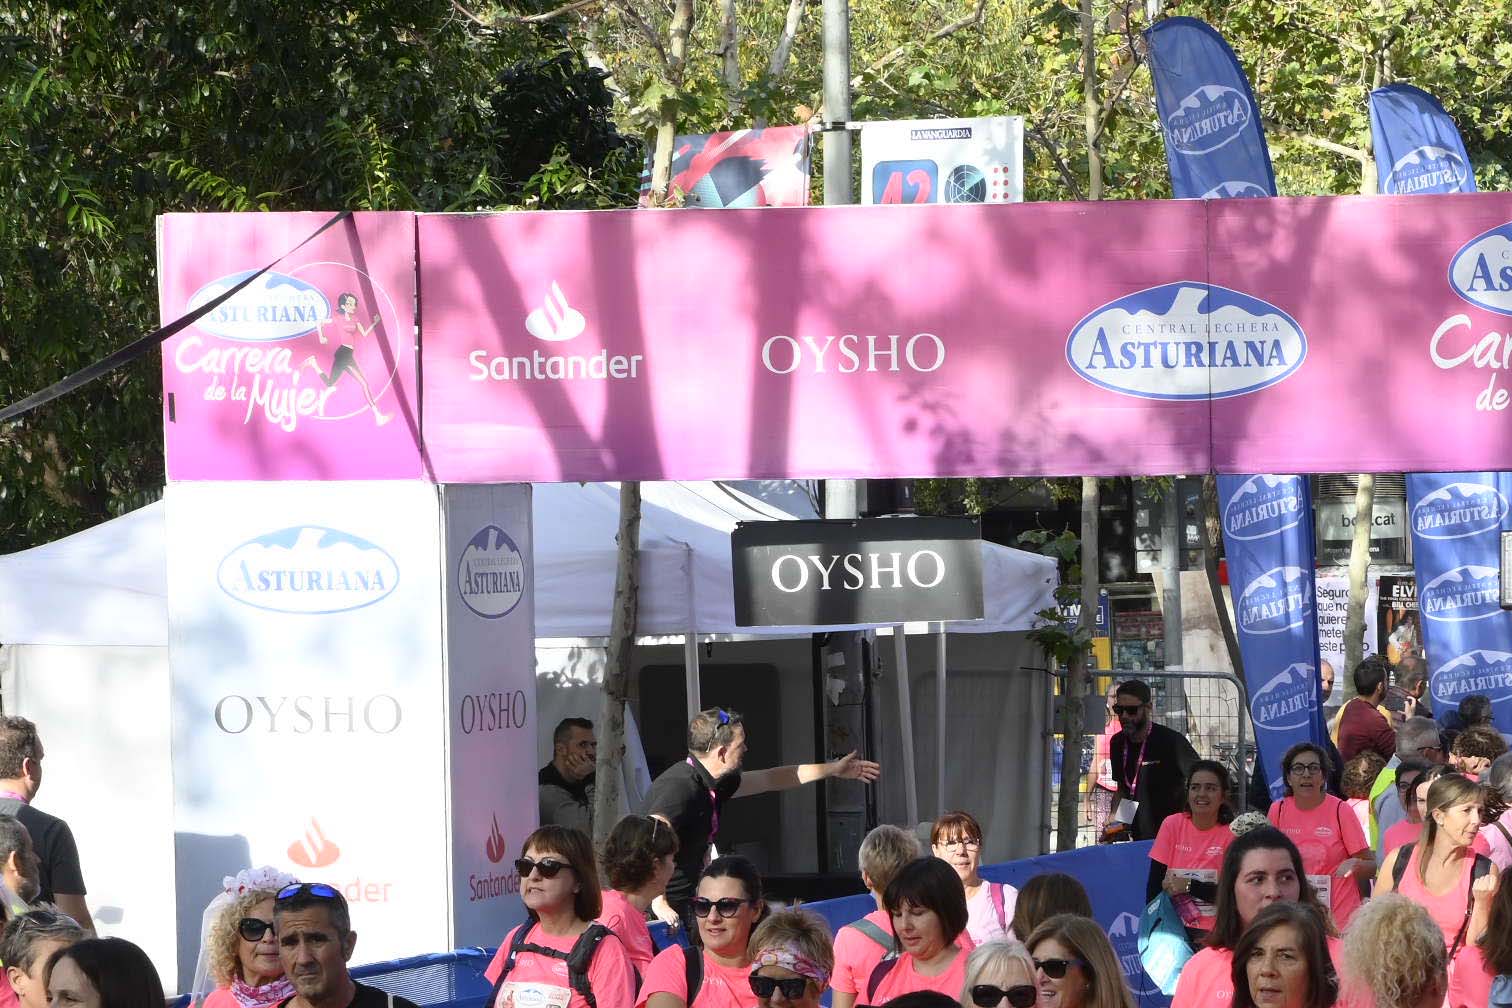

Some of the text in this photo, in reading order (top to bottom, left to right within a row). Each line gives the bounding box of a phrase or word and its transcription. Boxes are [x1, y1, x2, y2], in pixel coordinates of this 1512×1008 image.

[1122, 321, 1280, 335] CENTRAL LECHERA
[175, 336, 294, 375] Carrera
[469, 349, 643, 382] Santander
[761, 333, 946, 374] OYSHO
[1085, 326, 1288, 370] ASTURIANA
[203, 370, 337, 433] de la Mujer
[1475, 373, 1510, 411] de
[232, 559, 386, 592] ASTURIANA
[463, 560, 521, 595] ASTURIANA
[771, 549, 946, 593] OYSHO
[1318, 603, 1335, 614] que
[1320, 640, 1338, 652] este
[213, 694, 403, 735] OYSHO
[460, 690, 527, 735] OYSHO
